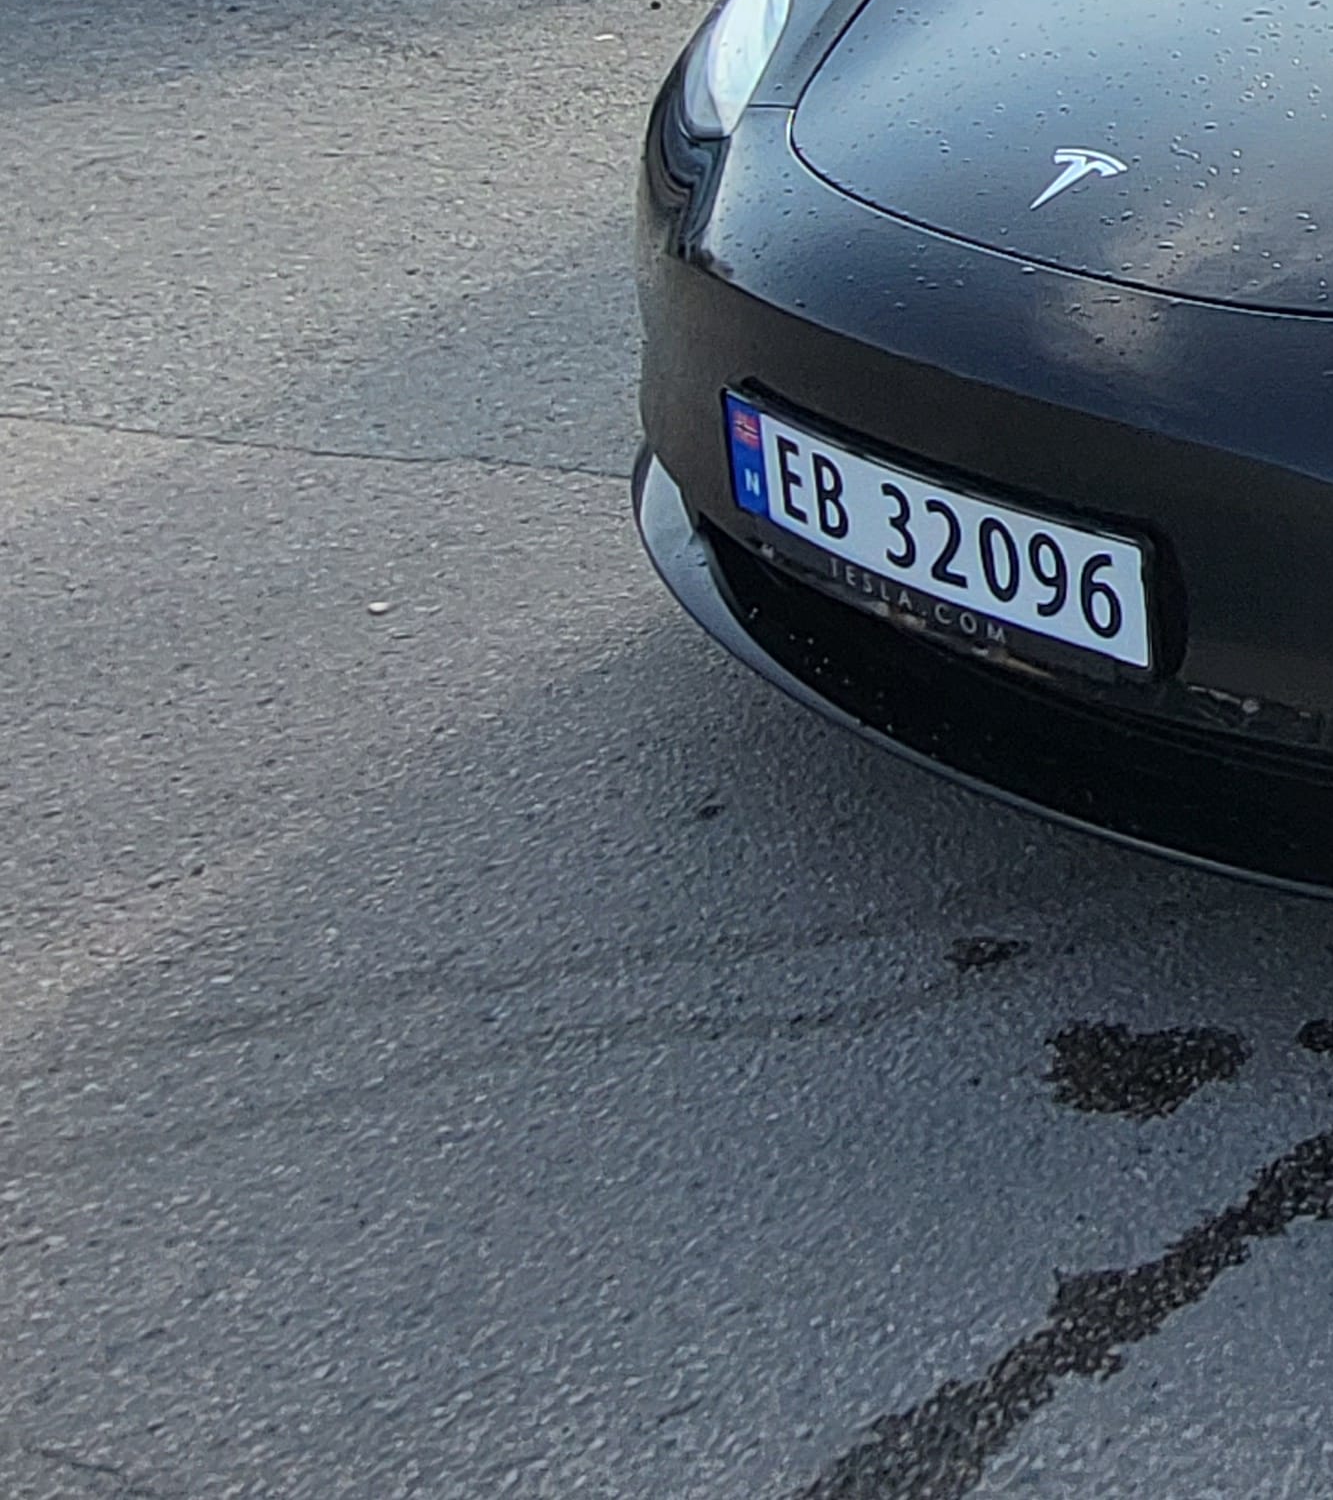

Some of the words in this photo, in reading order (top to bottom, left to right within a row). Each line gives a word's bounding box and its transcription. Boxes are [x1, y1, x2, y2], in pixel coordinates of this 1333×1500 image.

[743, 470, 762, 498] N
[775, 433, 850, 541] EB
[880, 482, 1123, 640] 32096
[829, 557, 1007, 645] TESLA.COM
